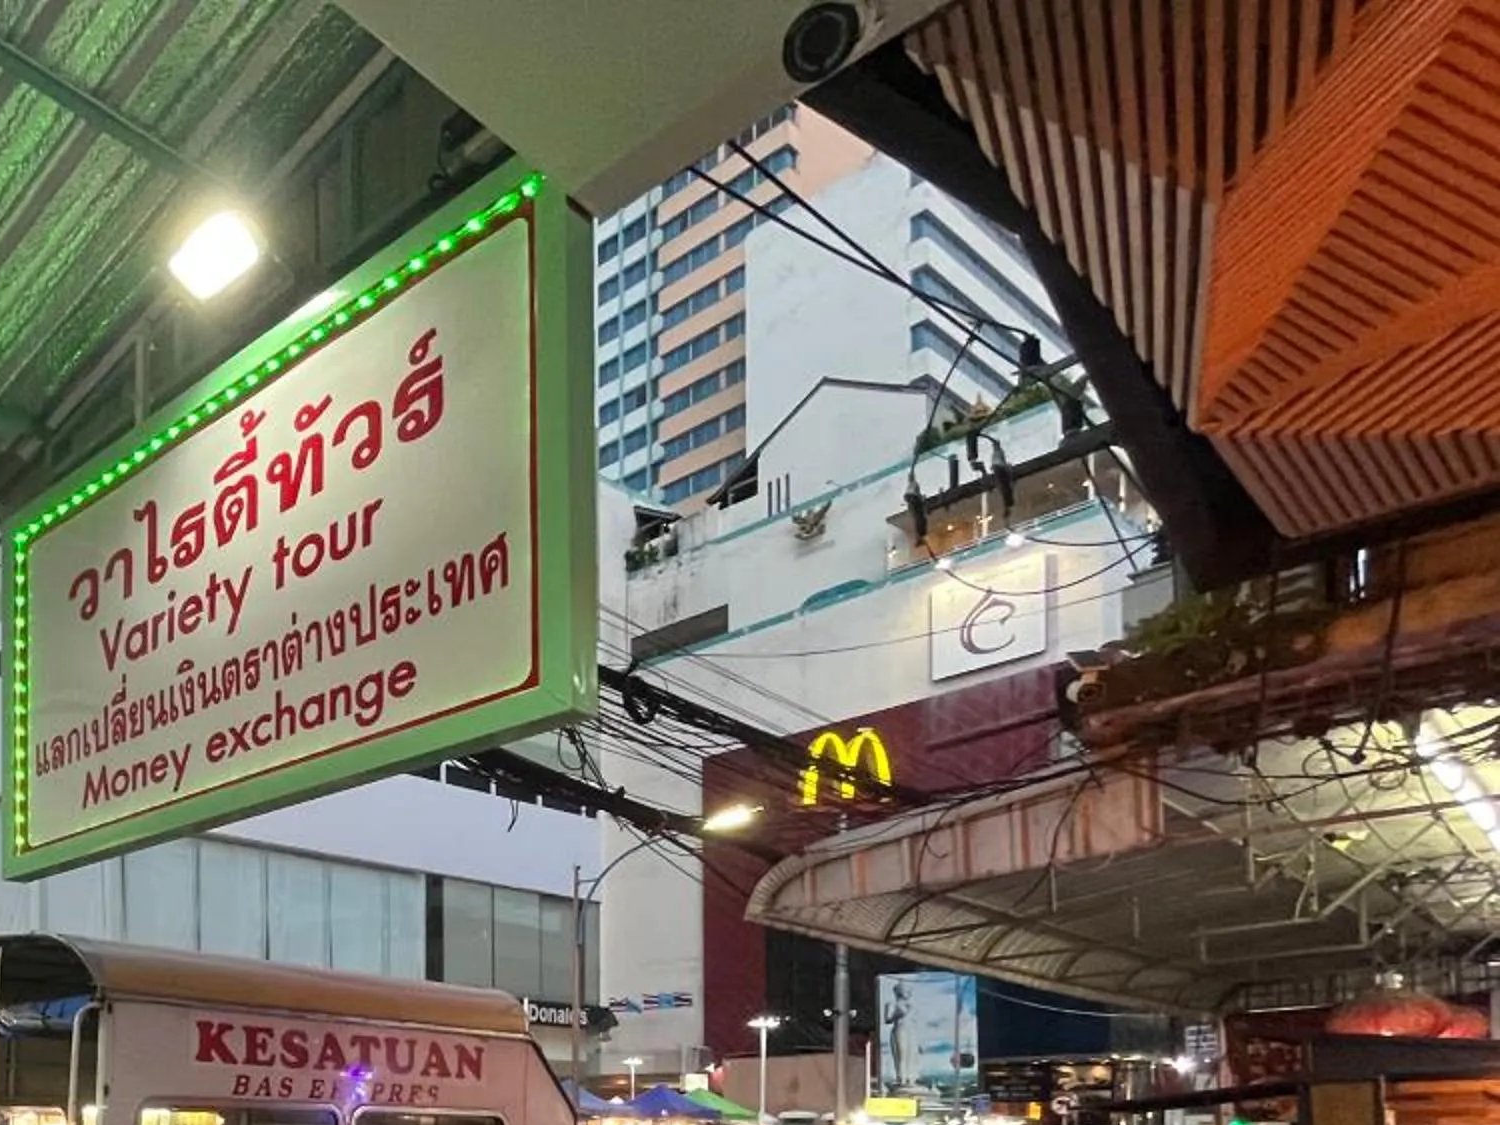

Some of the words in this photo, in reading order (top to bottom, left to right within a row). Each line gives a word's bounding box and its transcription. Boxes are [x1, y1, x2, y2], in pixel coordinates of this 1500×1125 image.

[69, 328, 444, 622] วาไรตี้ทัวร์
[34, 531, 510, 778] แลกเปลี่ยนเงินตราต่างประเทศ
[100, 566, 253, 672] Variety
[272, 498, 385, 590] tour
[82, 742, 191, 809] Money
[205, 659, 418, 764] exchange
[195, 1020, 486, 1081] KESATUAN
[232, 1074, 294, 1098] BAS
[529, 1003, 588, 1025] Donals
